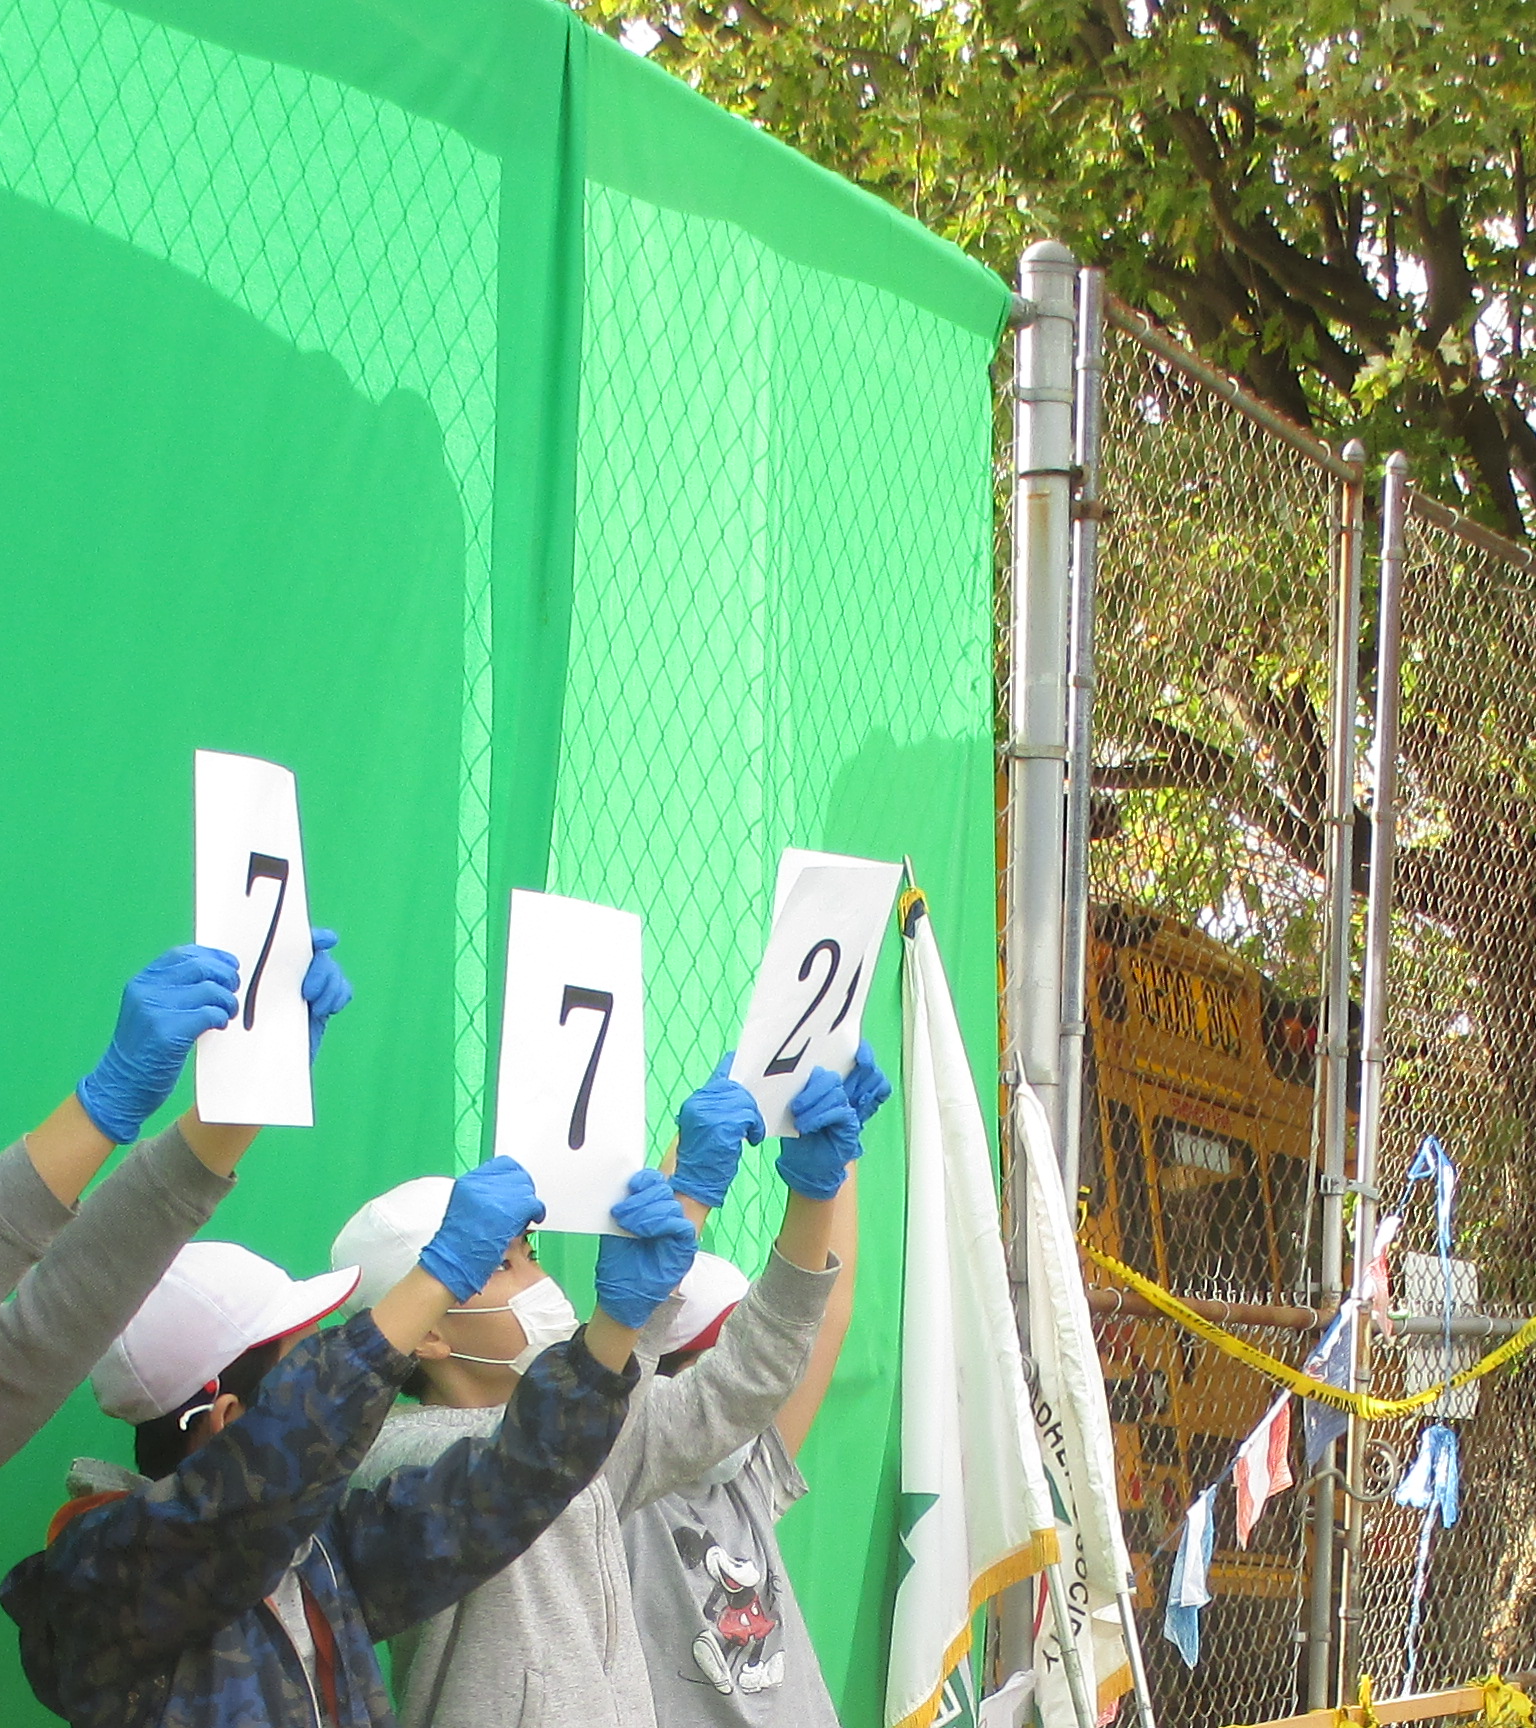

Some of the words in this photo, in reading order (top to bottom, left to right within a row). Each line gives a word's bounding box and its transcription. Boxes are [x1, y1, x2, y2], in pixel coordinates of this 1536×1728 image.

[244, 851, 289, 1031] 7
[763, 938, 841, 1078] 2
[559, 984, 614, 1150] 7
